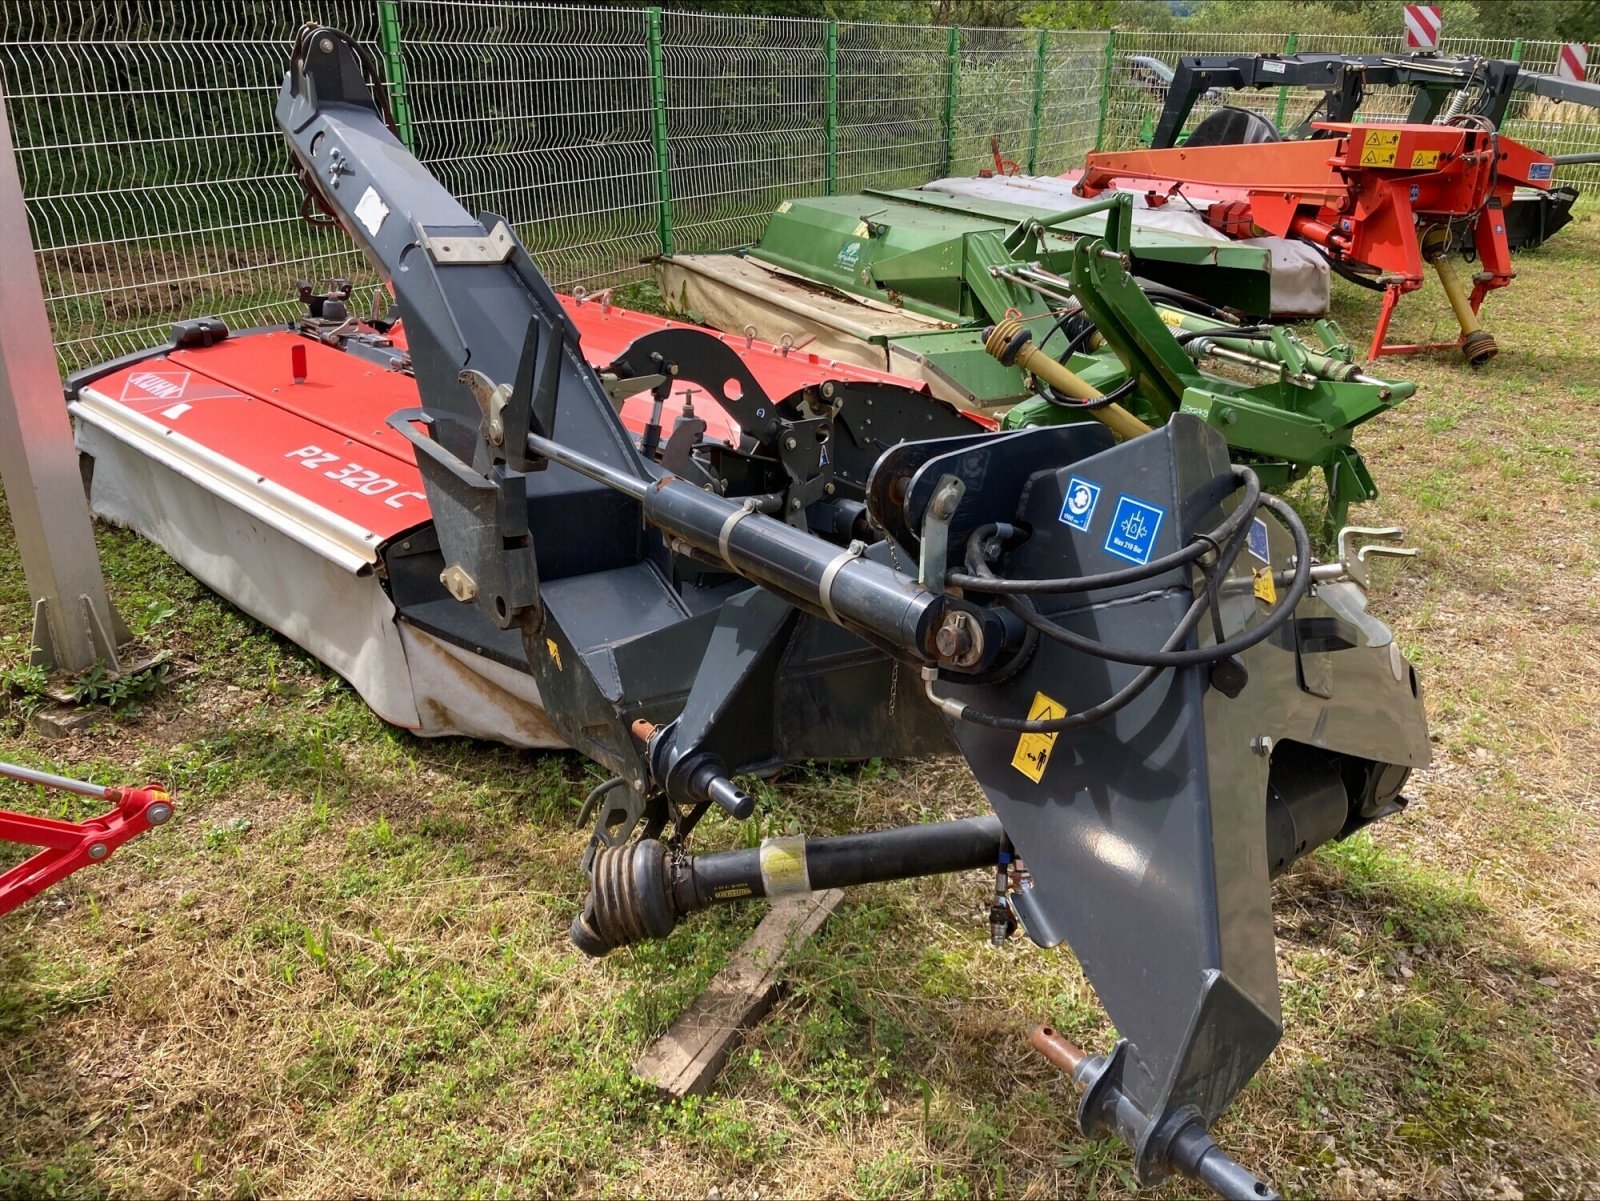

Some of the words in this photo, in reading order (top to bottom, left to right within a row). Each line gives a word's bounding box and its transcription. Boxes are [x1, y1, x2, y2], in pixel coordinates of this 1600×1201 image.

[128, 373, 183, 398] KUHN
[284, 445, 341, 469] PZ
[323, 463, 399, 496] 320
[384, 491, 427, 509] C
[1113, 537, 1125, 547] Max
[1123, 541, 1134, 551] 210
[1132, 545, 1143, 554] Bar
